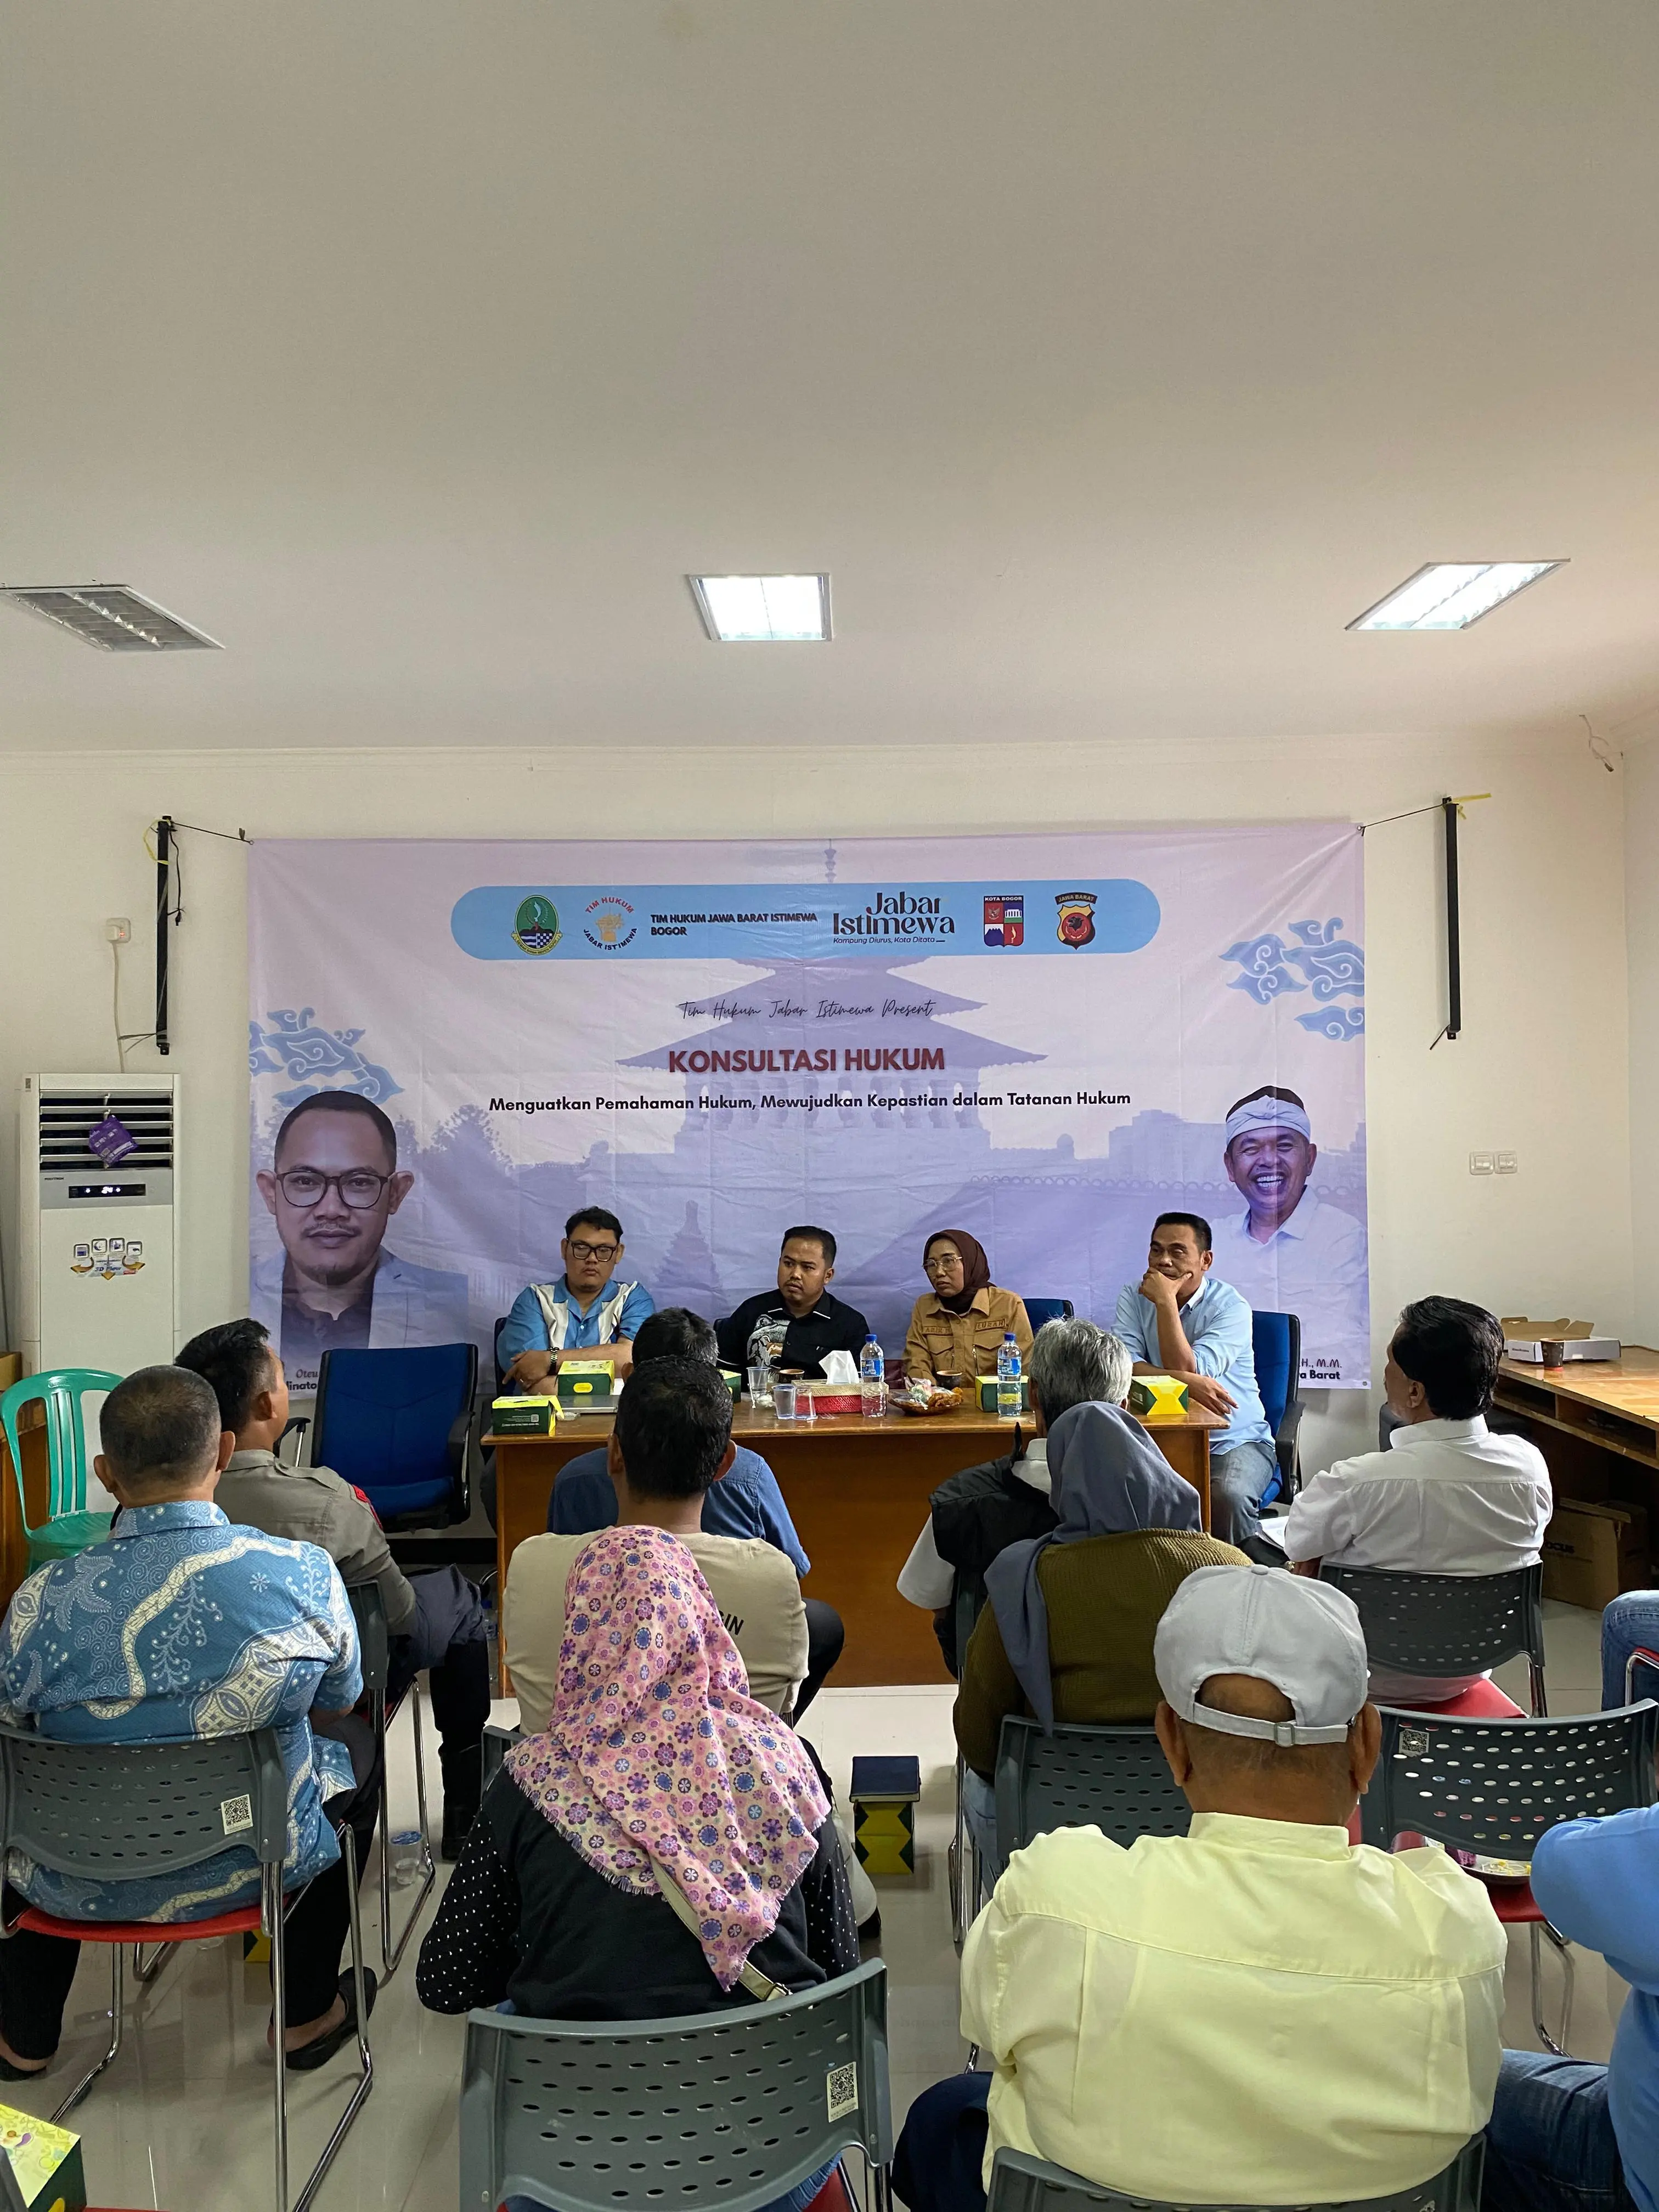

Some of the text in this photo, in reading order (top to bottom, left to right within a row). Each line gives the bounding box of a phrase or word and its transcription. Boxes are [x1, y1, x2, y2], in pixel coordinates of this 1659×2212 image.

[585, 896, 634, 913] TIM HUKUM
[866, 891, 941, 915] Jabar
[651, 912, 818, 923] TIM HUKUM JAWA BARAT ISTIMEWA
[833, 913, 955, 935] Istimewa
[583, 928, 603, 949] JABAR
[605, 928, 637, 950] ISTIMEWA
[651, 927, 689, 936] BOGOR
[680, 999, 936, 1019] Tim Hukum Jabar Istimewa Present
[669, 1047, 945, 1073] KONSULTASI HUKUM
[489, 1090, 1131, 1114] Menguatkan Pemahaman Hukum, Mewujudkan Kepastian dalam Tatanan Hukum
[1310, 1370, 1340, 1379] Barat
